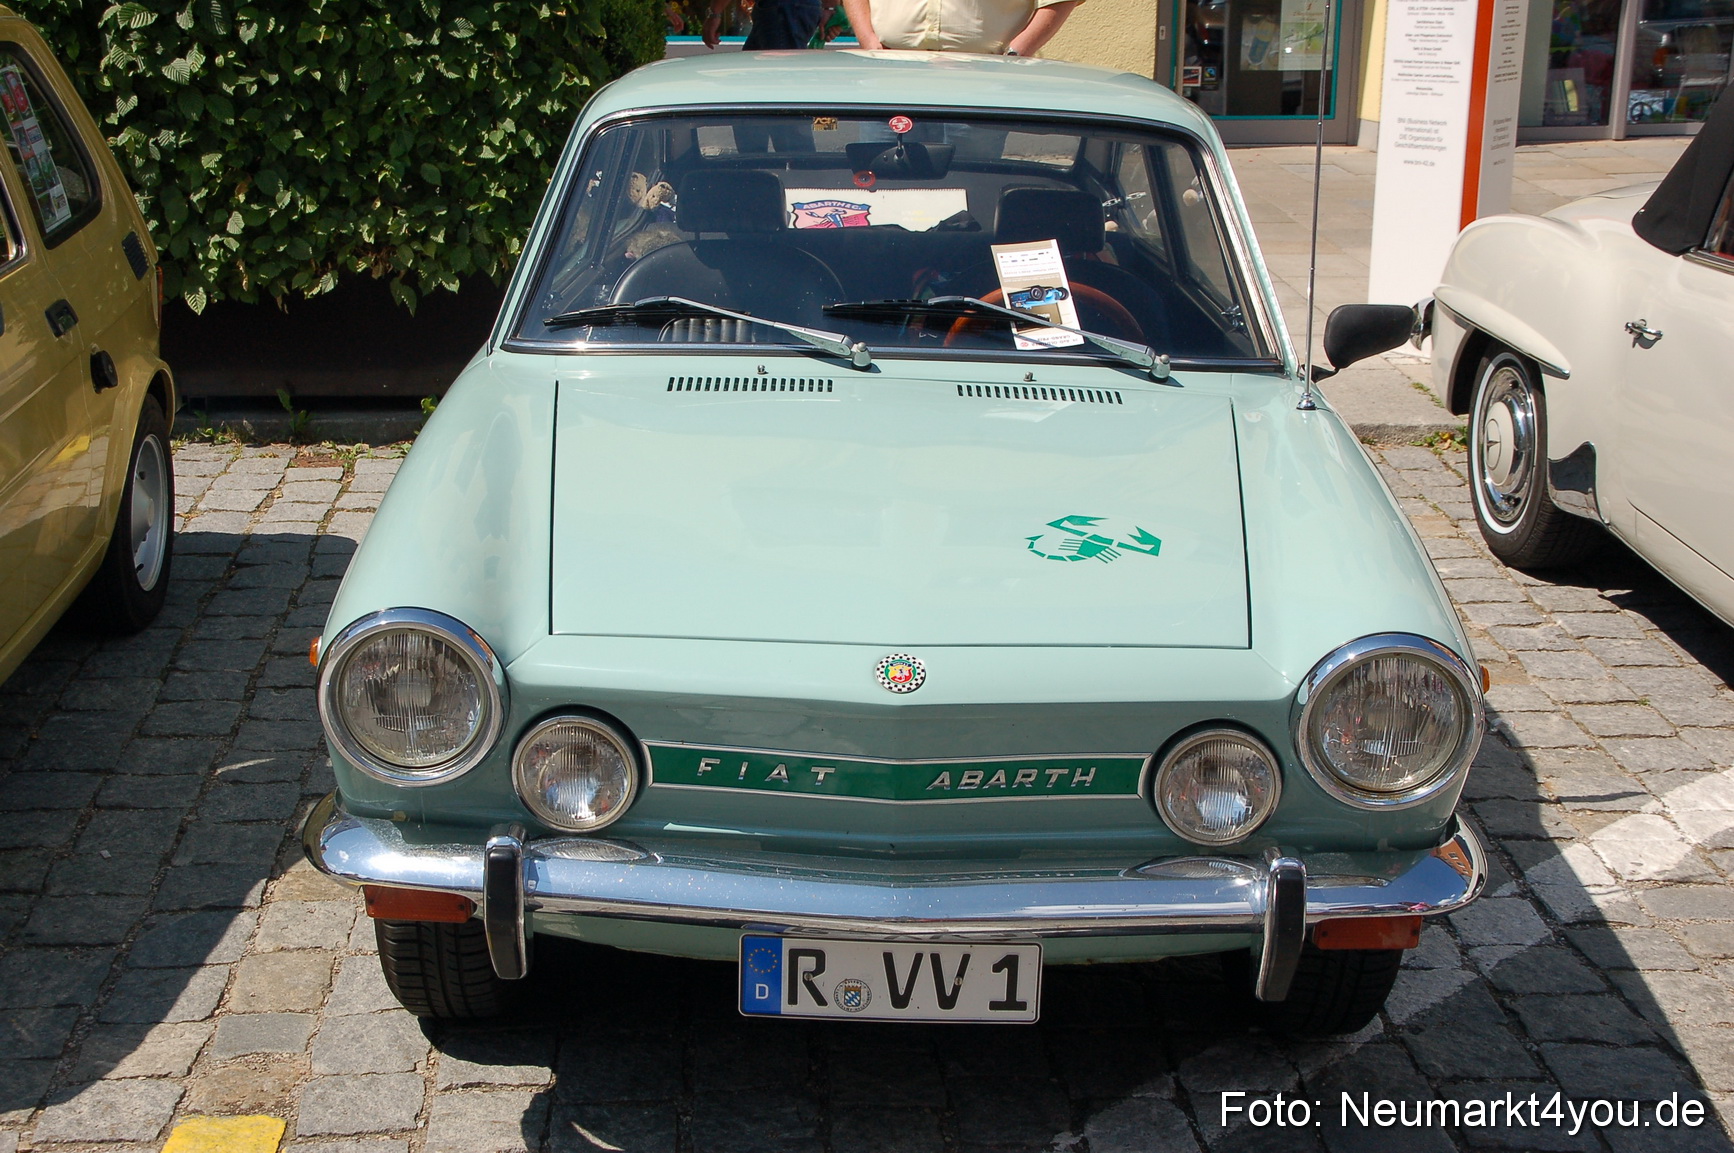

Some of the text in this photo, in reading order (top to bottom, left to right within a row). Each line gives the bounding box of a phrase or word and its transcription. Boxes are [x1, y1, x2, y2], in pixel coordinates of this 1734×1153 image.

[696, 757, 1096, 790] FIAT ABARTH
[755, 984, 769, 999] D
[787, 948, 828, 1007] R
[881, 951, 971, 1011] VV
[988, 954, 1028, 1012] 1
